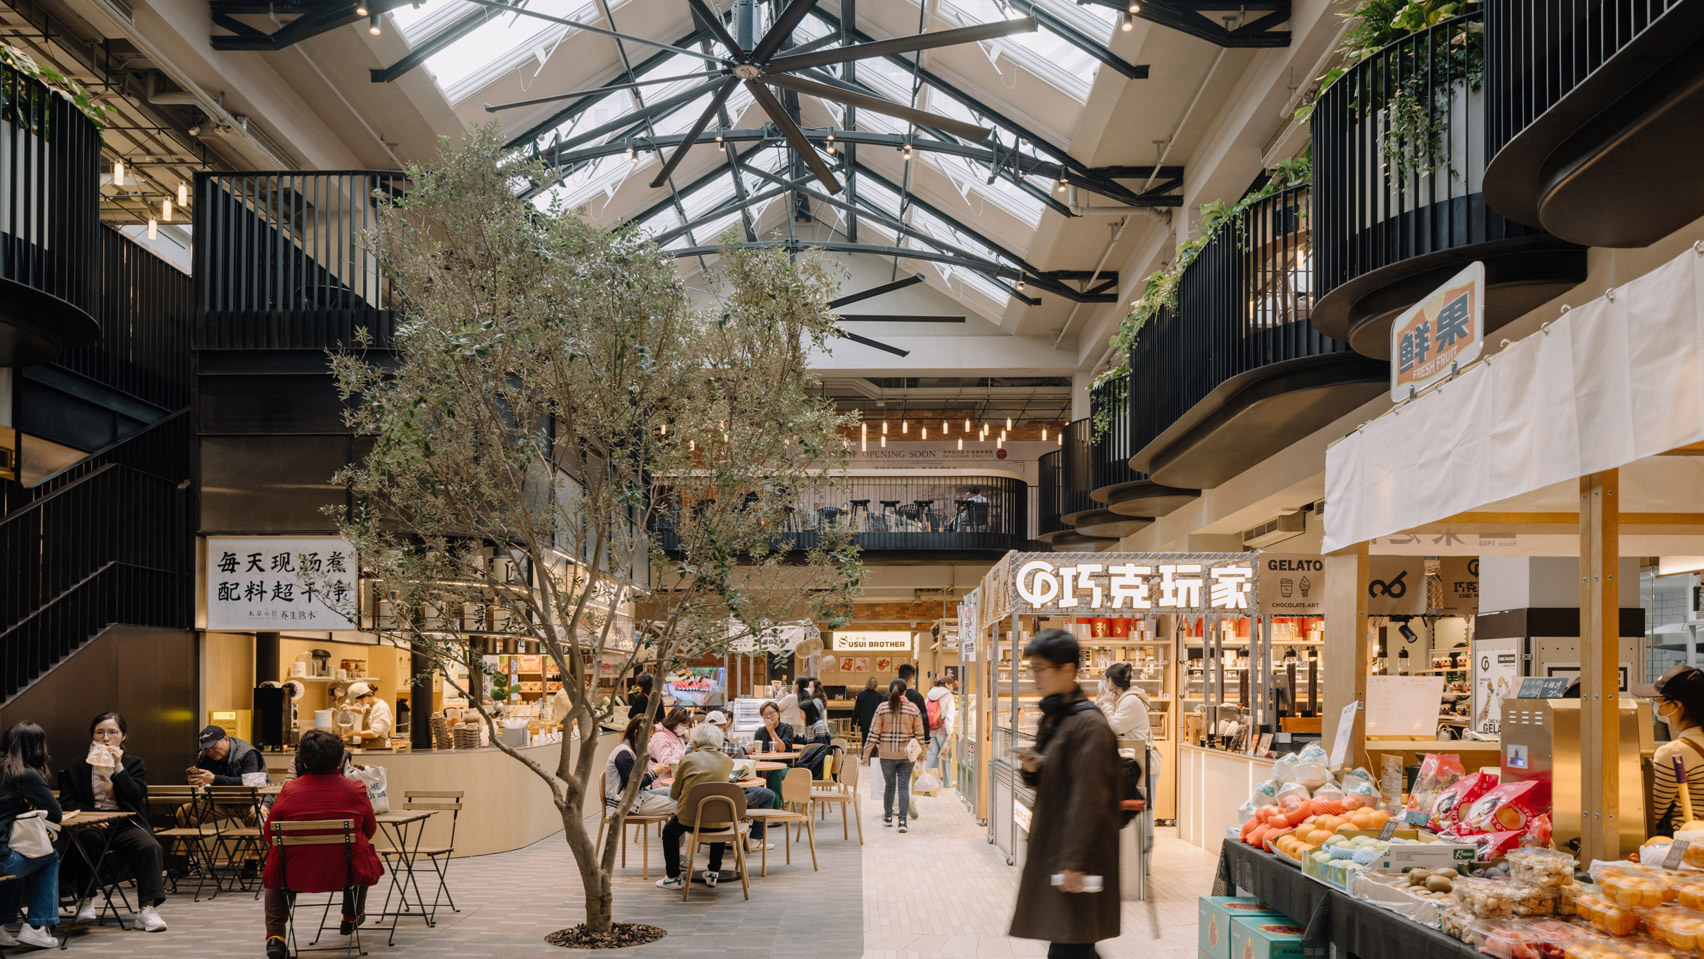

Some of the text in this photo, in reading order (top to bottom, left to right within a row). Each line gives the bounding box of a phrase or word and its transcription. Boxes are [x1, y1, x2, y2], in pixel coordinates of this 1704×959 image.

[1413, 345, 1459, 380] FRESH FRUIT
[861, 450, 905, 459] OPENING
[909, 450, 937, 459] SOON
[1268, 559, 1324, 571] GELATO
[1058, 563, 1253, 609] 巧克玩家
[1453, 581, 1479, 593] 巧克
